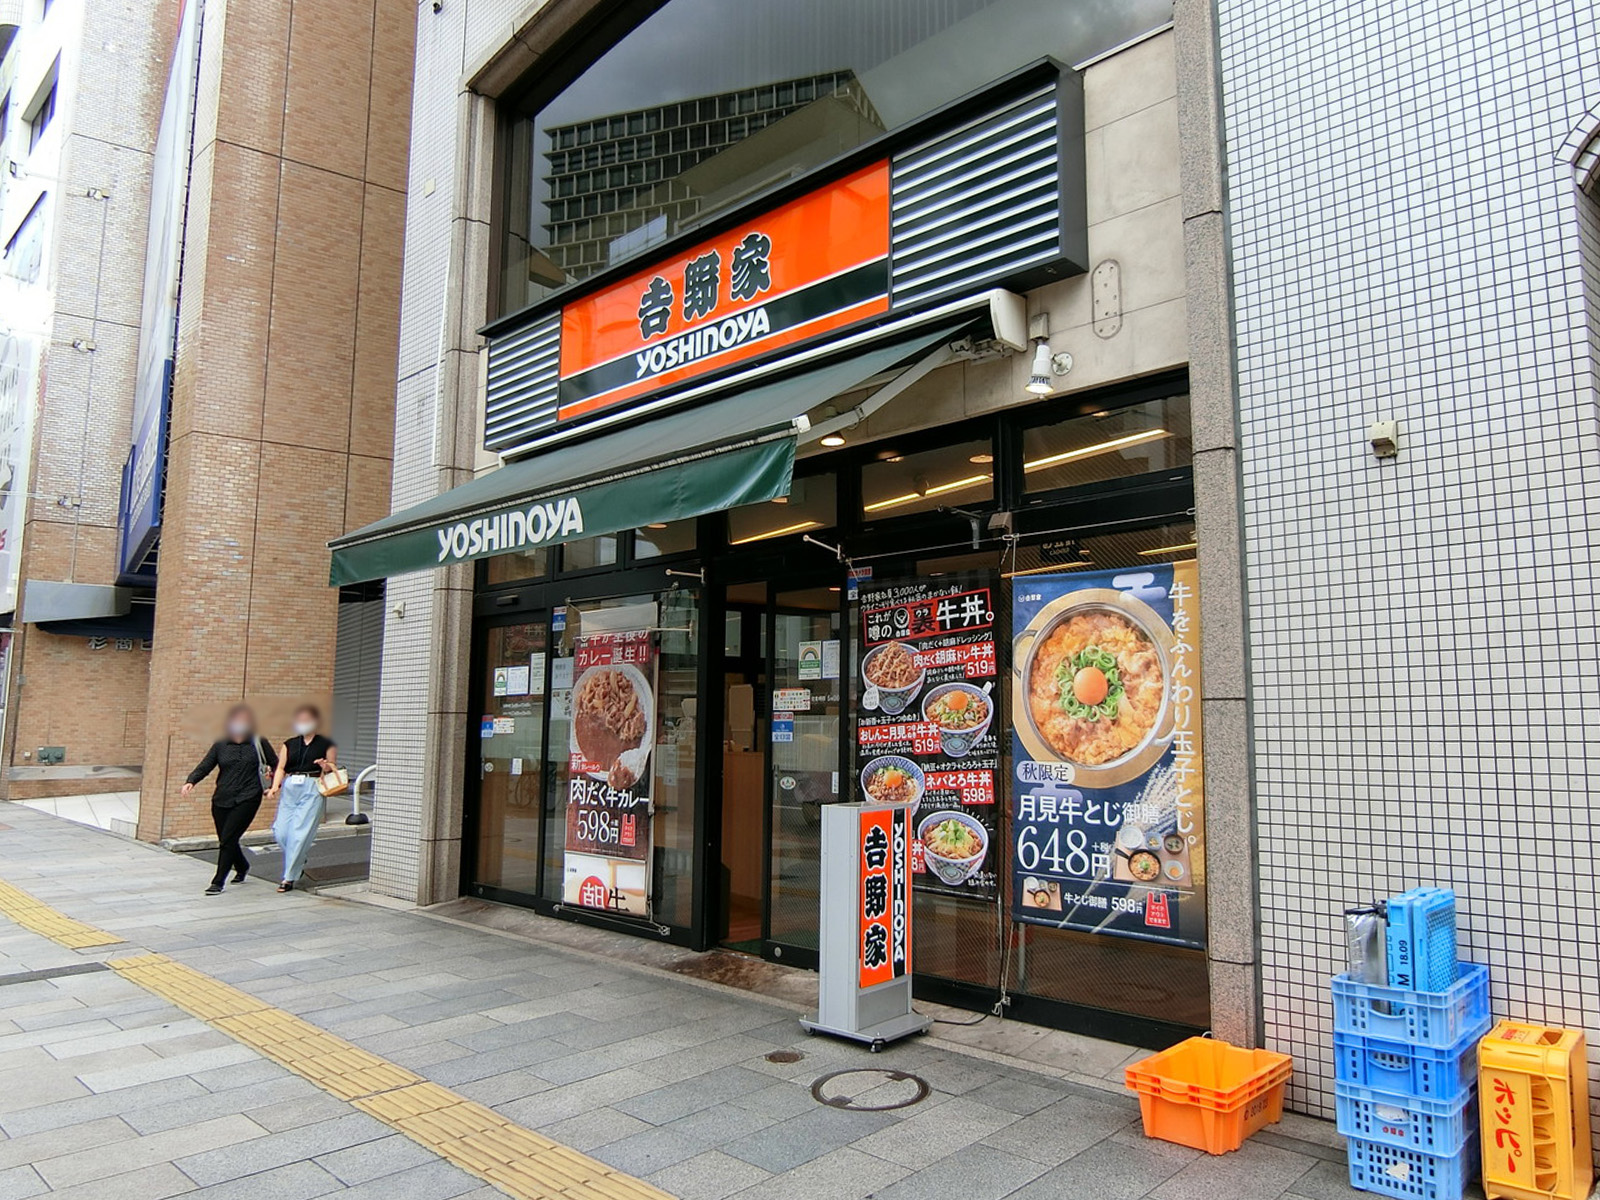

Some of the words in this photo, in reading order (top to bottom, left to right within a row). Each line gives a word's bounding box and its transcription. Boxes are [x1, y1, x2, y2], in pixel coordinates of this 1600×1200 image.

[638, 232, 771, 340] 吉野家
[636, 307, 770, 378] YOSHINOYA
[438, 497, 583, 562] YOSHINOYA
[868, 610, 891, 624] これが
[868, 624, 892, 640] 噂の
[913, 643, 993, 668] 肉だく胡麻ドレ牛丼
[1168, 582, 1196, 845] 牛をふんわり玉子とじ。
[926, 771, 991, 788] ネバとろ牛丼
[1022, 764, 1070, 782] 秋限定
[570, 776, 650, 808] 肉だく牛カレー
[1017, 794, 1160, 826] 月見牛とじ御膳
[864, 825, 888, 969] 吉野家
[893, 822, 904, 962] YOSHINOYA
[1064, 892, 1107, 909] 牛とじ御膳
[1398, 939, 1408, 965] 18.09
[1397, 973, 1410, 986] M
